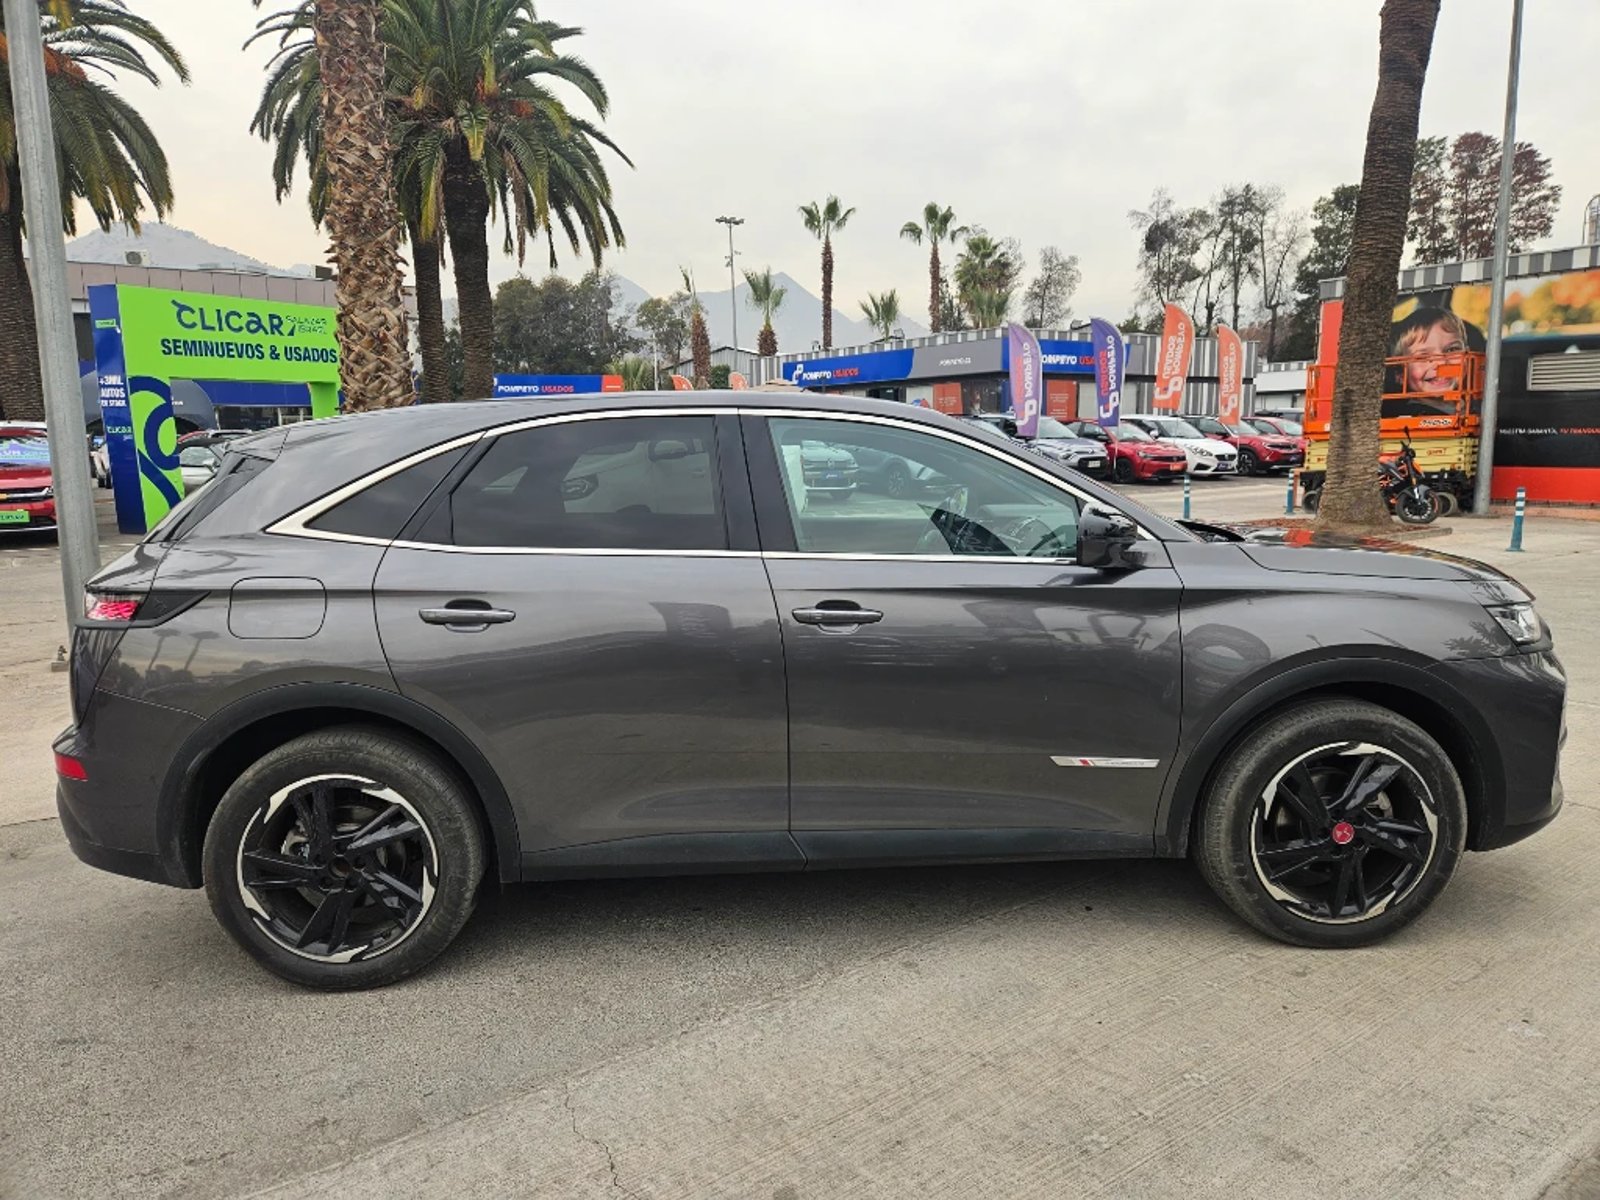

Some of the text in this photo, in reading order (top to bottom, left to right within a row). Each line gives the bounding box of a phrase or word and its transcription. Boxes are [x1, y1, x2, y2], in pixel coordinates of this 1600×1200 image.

[160, 338, 338, 363] SEMINUEVOS & USADOS
[1041, 354, 1077, 365] OMPEYO
[802, 370, 832, 381] POMPEYO
[100, 388, 126, 398] AUTOS
[498, 385, 574, 393] POMPEYO USADOS
